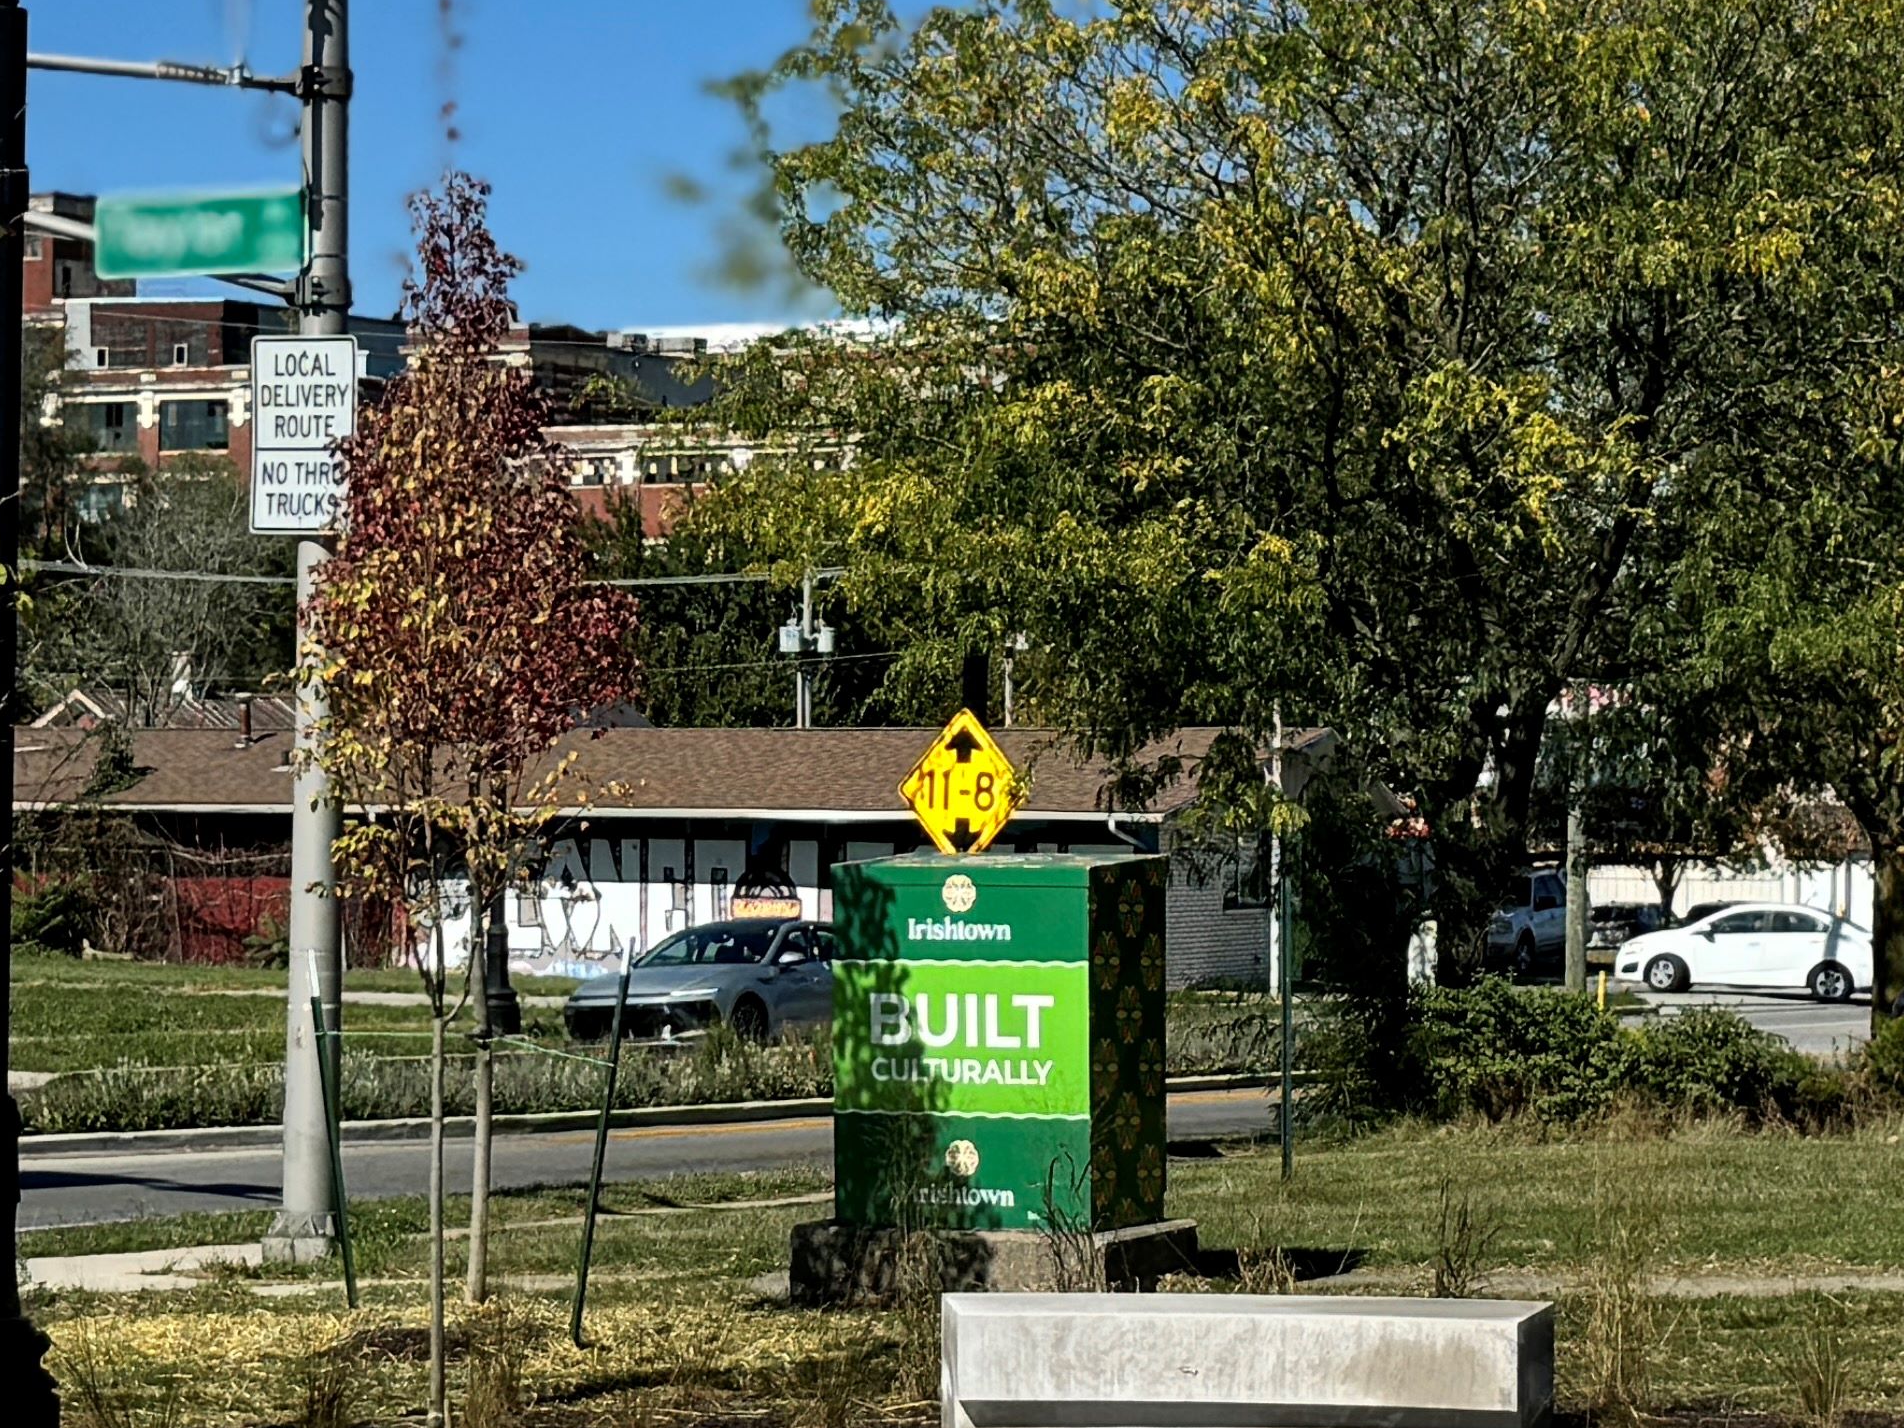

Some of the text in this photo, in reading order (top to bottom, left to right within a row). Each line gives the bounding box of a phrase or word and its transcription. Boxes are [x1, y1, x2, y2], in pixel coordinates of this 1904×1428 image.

[274, 353, 336, 377] LOCAL
[261, 384, 349, 408] DELIVERY
[275, 415, 336, 439] ROUTE
[262, 462, 288, 486] NO
[266, 493, 339, 516] TRUCKS
[907, 917, 1011, 942] Irishtown
[869, 993, 1055, 1049] BUILT
[871, 1058, 1053, 1086] CULTURALLY
